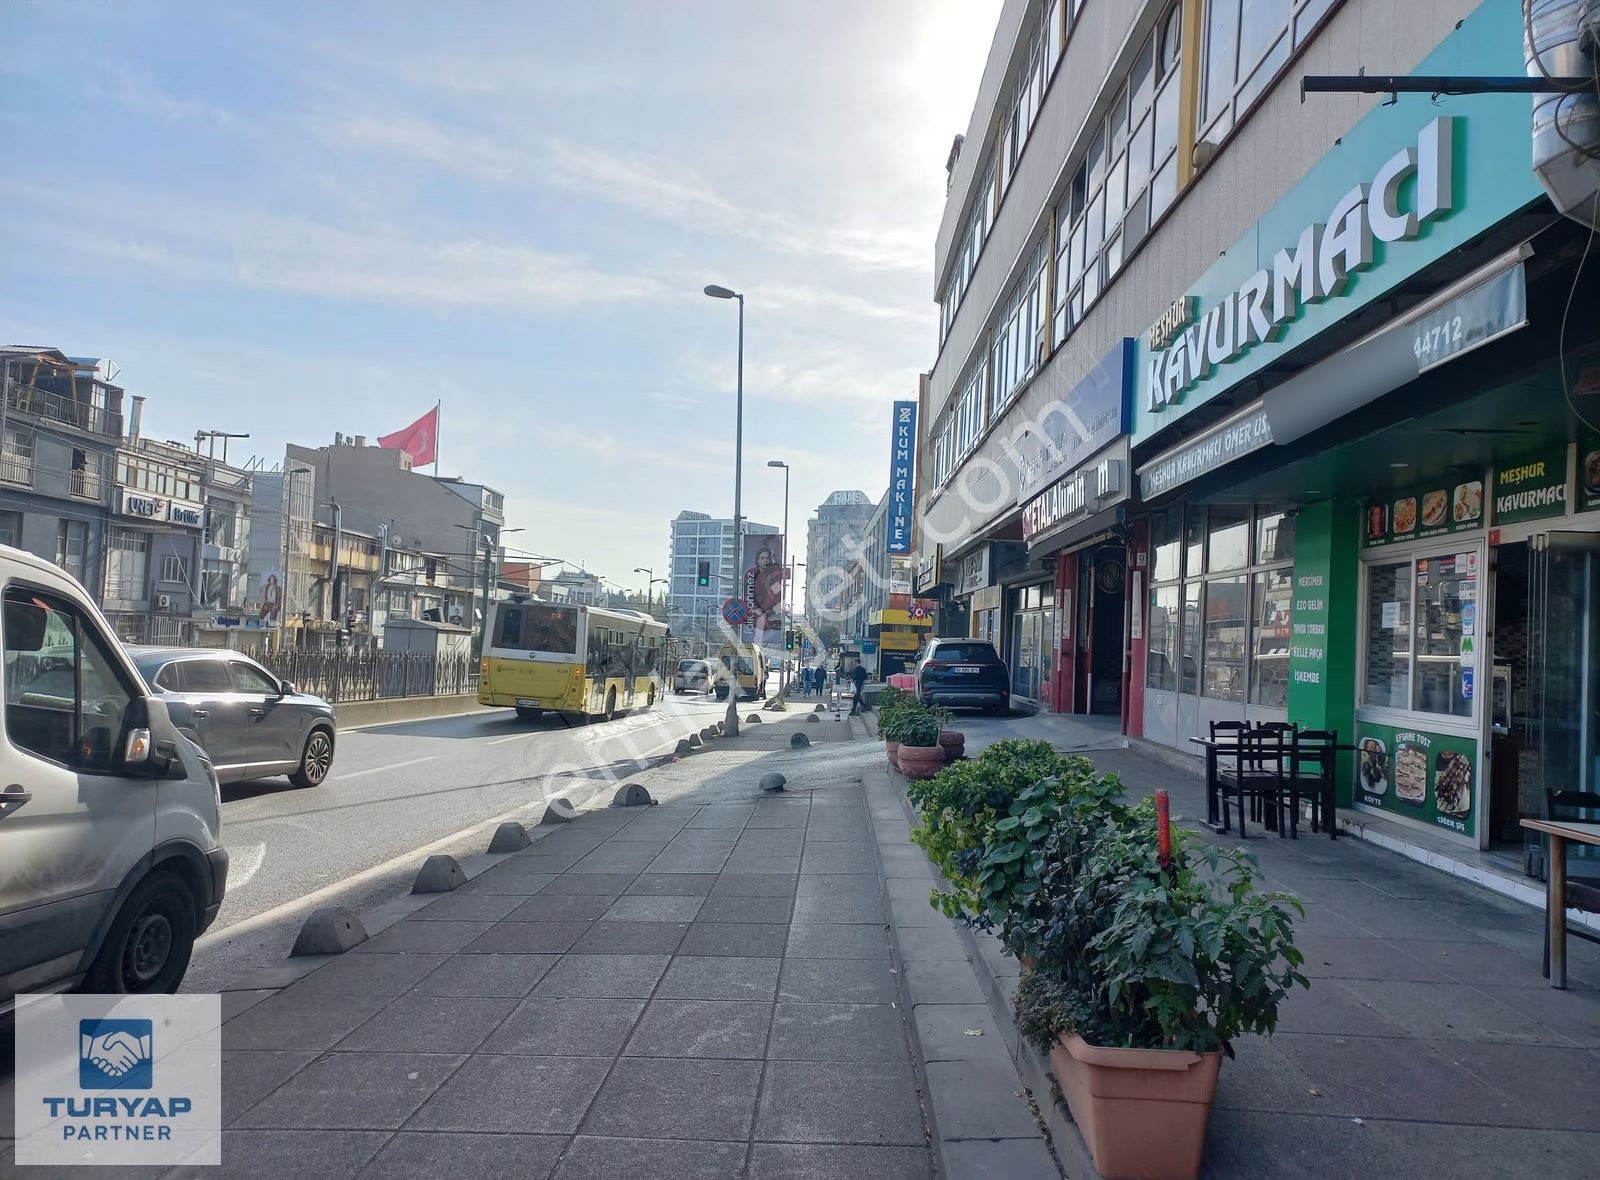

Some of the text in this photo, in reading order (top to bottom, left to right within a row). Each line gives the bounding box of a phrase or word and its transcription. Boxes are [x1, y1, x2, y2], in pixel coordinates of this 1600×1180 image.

[1146, 115, 1452, 412] KAVURMACI
[1176, 438, 1222, 476] KAVURMACI
[1224, 422, 1251, 451] ÖMER
[1500, 461, 1545, 484] MEŞHUR
[894, 425, 909, 540] KUM MAKİNE
[834, 492, 861, 502] RAMS
[1497, 483, 1567, 513] KAVURMACI
[1298, 574, 1323, 587] MERCİMEK
[1307, 597, 1323, 610] GELİN
[1306, 623, 1325, 636] ÇORBASI
[1293, 647, 1323, 661] KELLE PAÇA
[1294, 669, 1320, 684] İŞKEMBE
[1395, 732, 1431, 748] EFSANE TOST
[1364, 795, 1382, 806] KÖFTE
[1455, 820, 1465, 832] ŞİŞ
